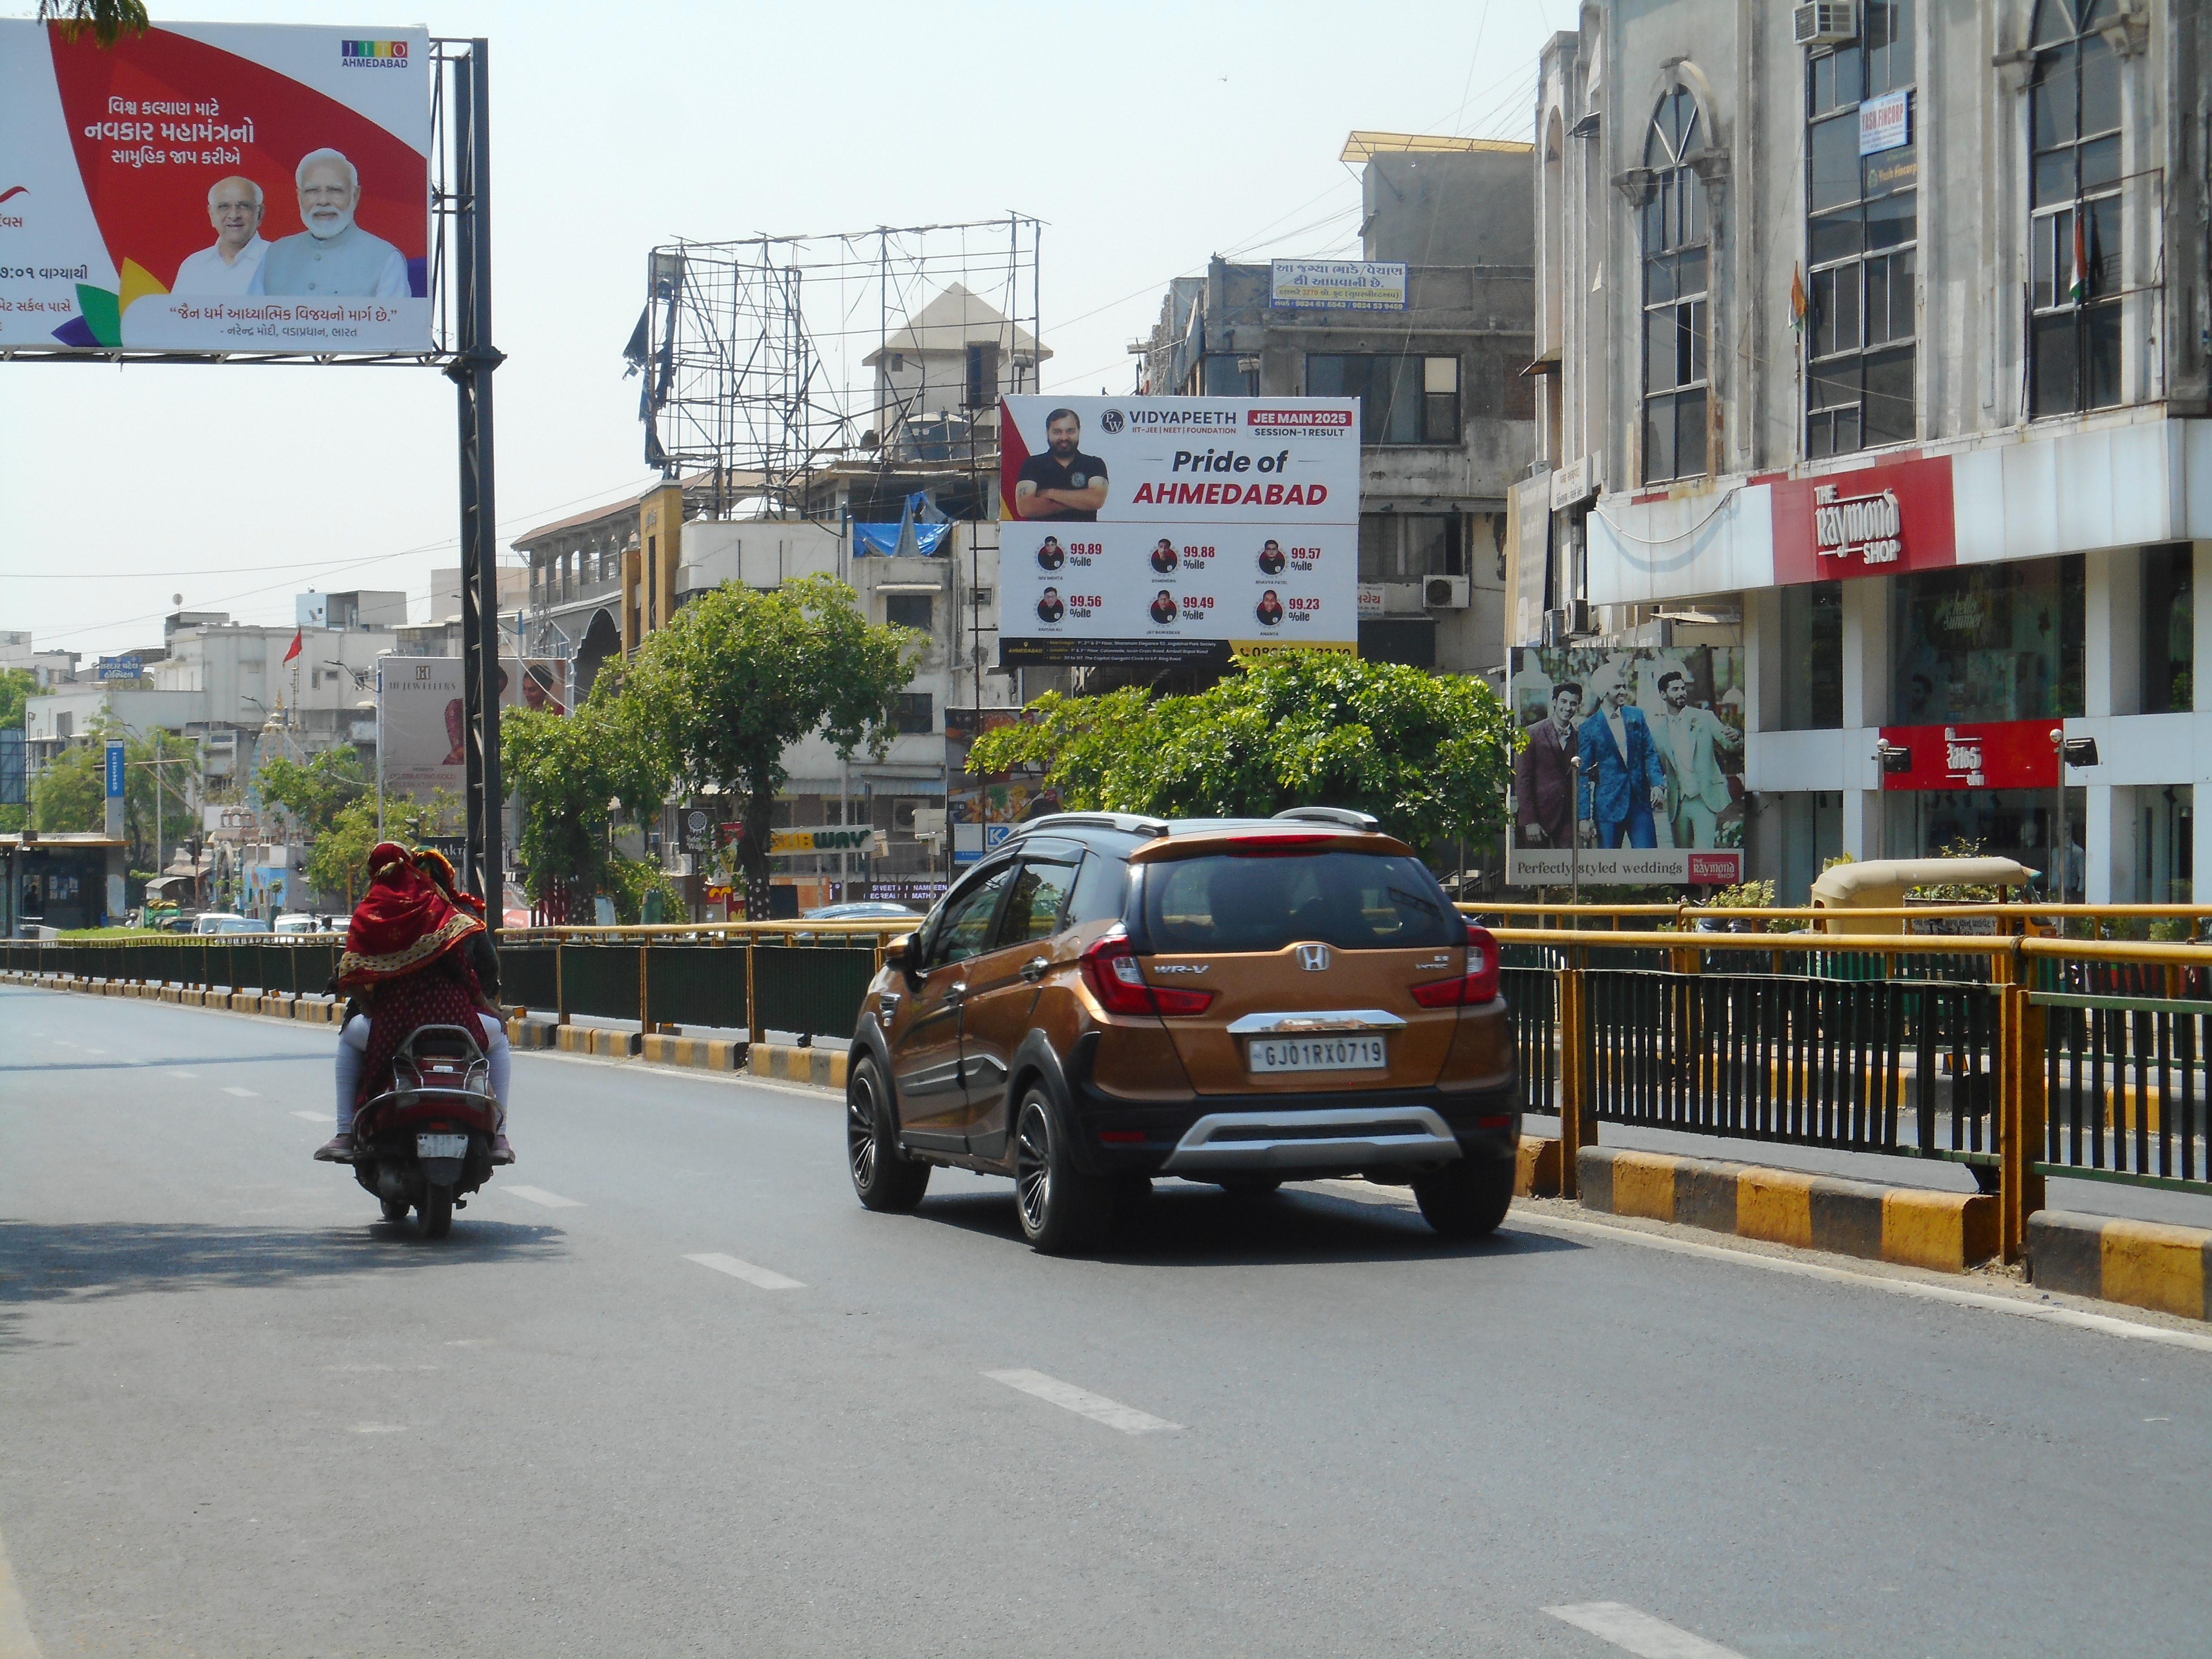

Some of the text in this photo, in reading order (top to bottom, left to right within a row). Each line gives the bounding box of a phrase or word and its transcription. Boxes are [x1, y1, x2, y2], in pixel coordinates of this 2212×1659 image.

[344, 40, 407, 58] JITO
[342, 58, 408, 68] AHMEDABAD
[109, 96, 220, 116] વિશ્વ કલ્યાણ માટે
[85, 117, 254, 143] નવકાર મહામંત્રનો
[111, 145, 240, 168] સામુહિક જાપ કરીએ
[39, 264, 88, 279] વાગ્યાથી
[1276, 264, 1293, 273] આ
[1297, 264, 1329, 273] જગ્યા
[1294, 275, 1385, 288] થી આપવાની છે.
[16, 298, 45, 312] સર્કલ
[48, 299, 71, 312] પાસે
[204, 304, 223, 320] ધર્મ
[227, 305, 291, 321] આધ્યાત્મિક
[296, 304, 344, 321] વિજયનો
[349, 305, 372, 322] માર્ગ
[227, 324, 254, 336] નરેન્દ્ર
[282, 326, 328, 338] વડાપ્રધાન,
[331, 327, 357, 337] ભારત
[1129, 411, 1236, 425] VIDYAPEETH
[1253, 413, 1346, 424] JEE MAIN 2025
[1255, 428, 1345, 437] SESSION-1 RESULT
[1172, 449, 1289, 474] Pride of
[1132, 483, 1328, 506] AHMEDABAD
[1814, 484, 1837, 505] THE
[1070, 543, 1102, 555] 99.89
[1184, 546, 1215, 558] 99.88
[1291, 547, 1321, 559] 99.57
[1863, 539, 1901, 564] SHOP
[1070, 557, 1091, 567] %ile
[1183, 559, 1205, 569] %ile
[1291, 561, 1313, 571] %ile
[1070, 596, 1102, 607] 99.56
[1183, 596, 1214, 608] 99.49
[1289, 598, 1320, 610] 99.23
[1069, 608, 1091, 618] %ile
[1182, 610, 1204, 620] %ile
[1288, 612, 1310, 622] %ile
[771, 829, 872, 853] SUBWAY
[1517, 862, 1683, 876] Perfectly styled weddings
[1154, 965, 1209, 974] WR-V
[1266, 1042, 1381, 1066] GJ01RX0719
